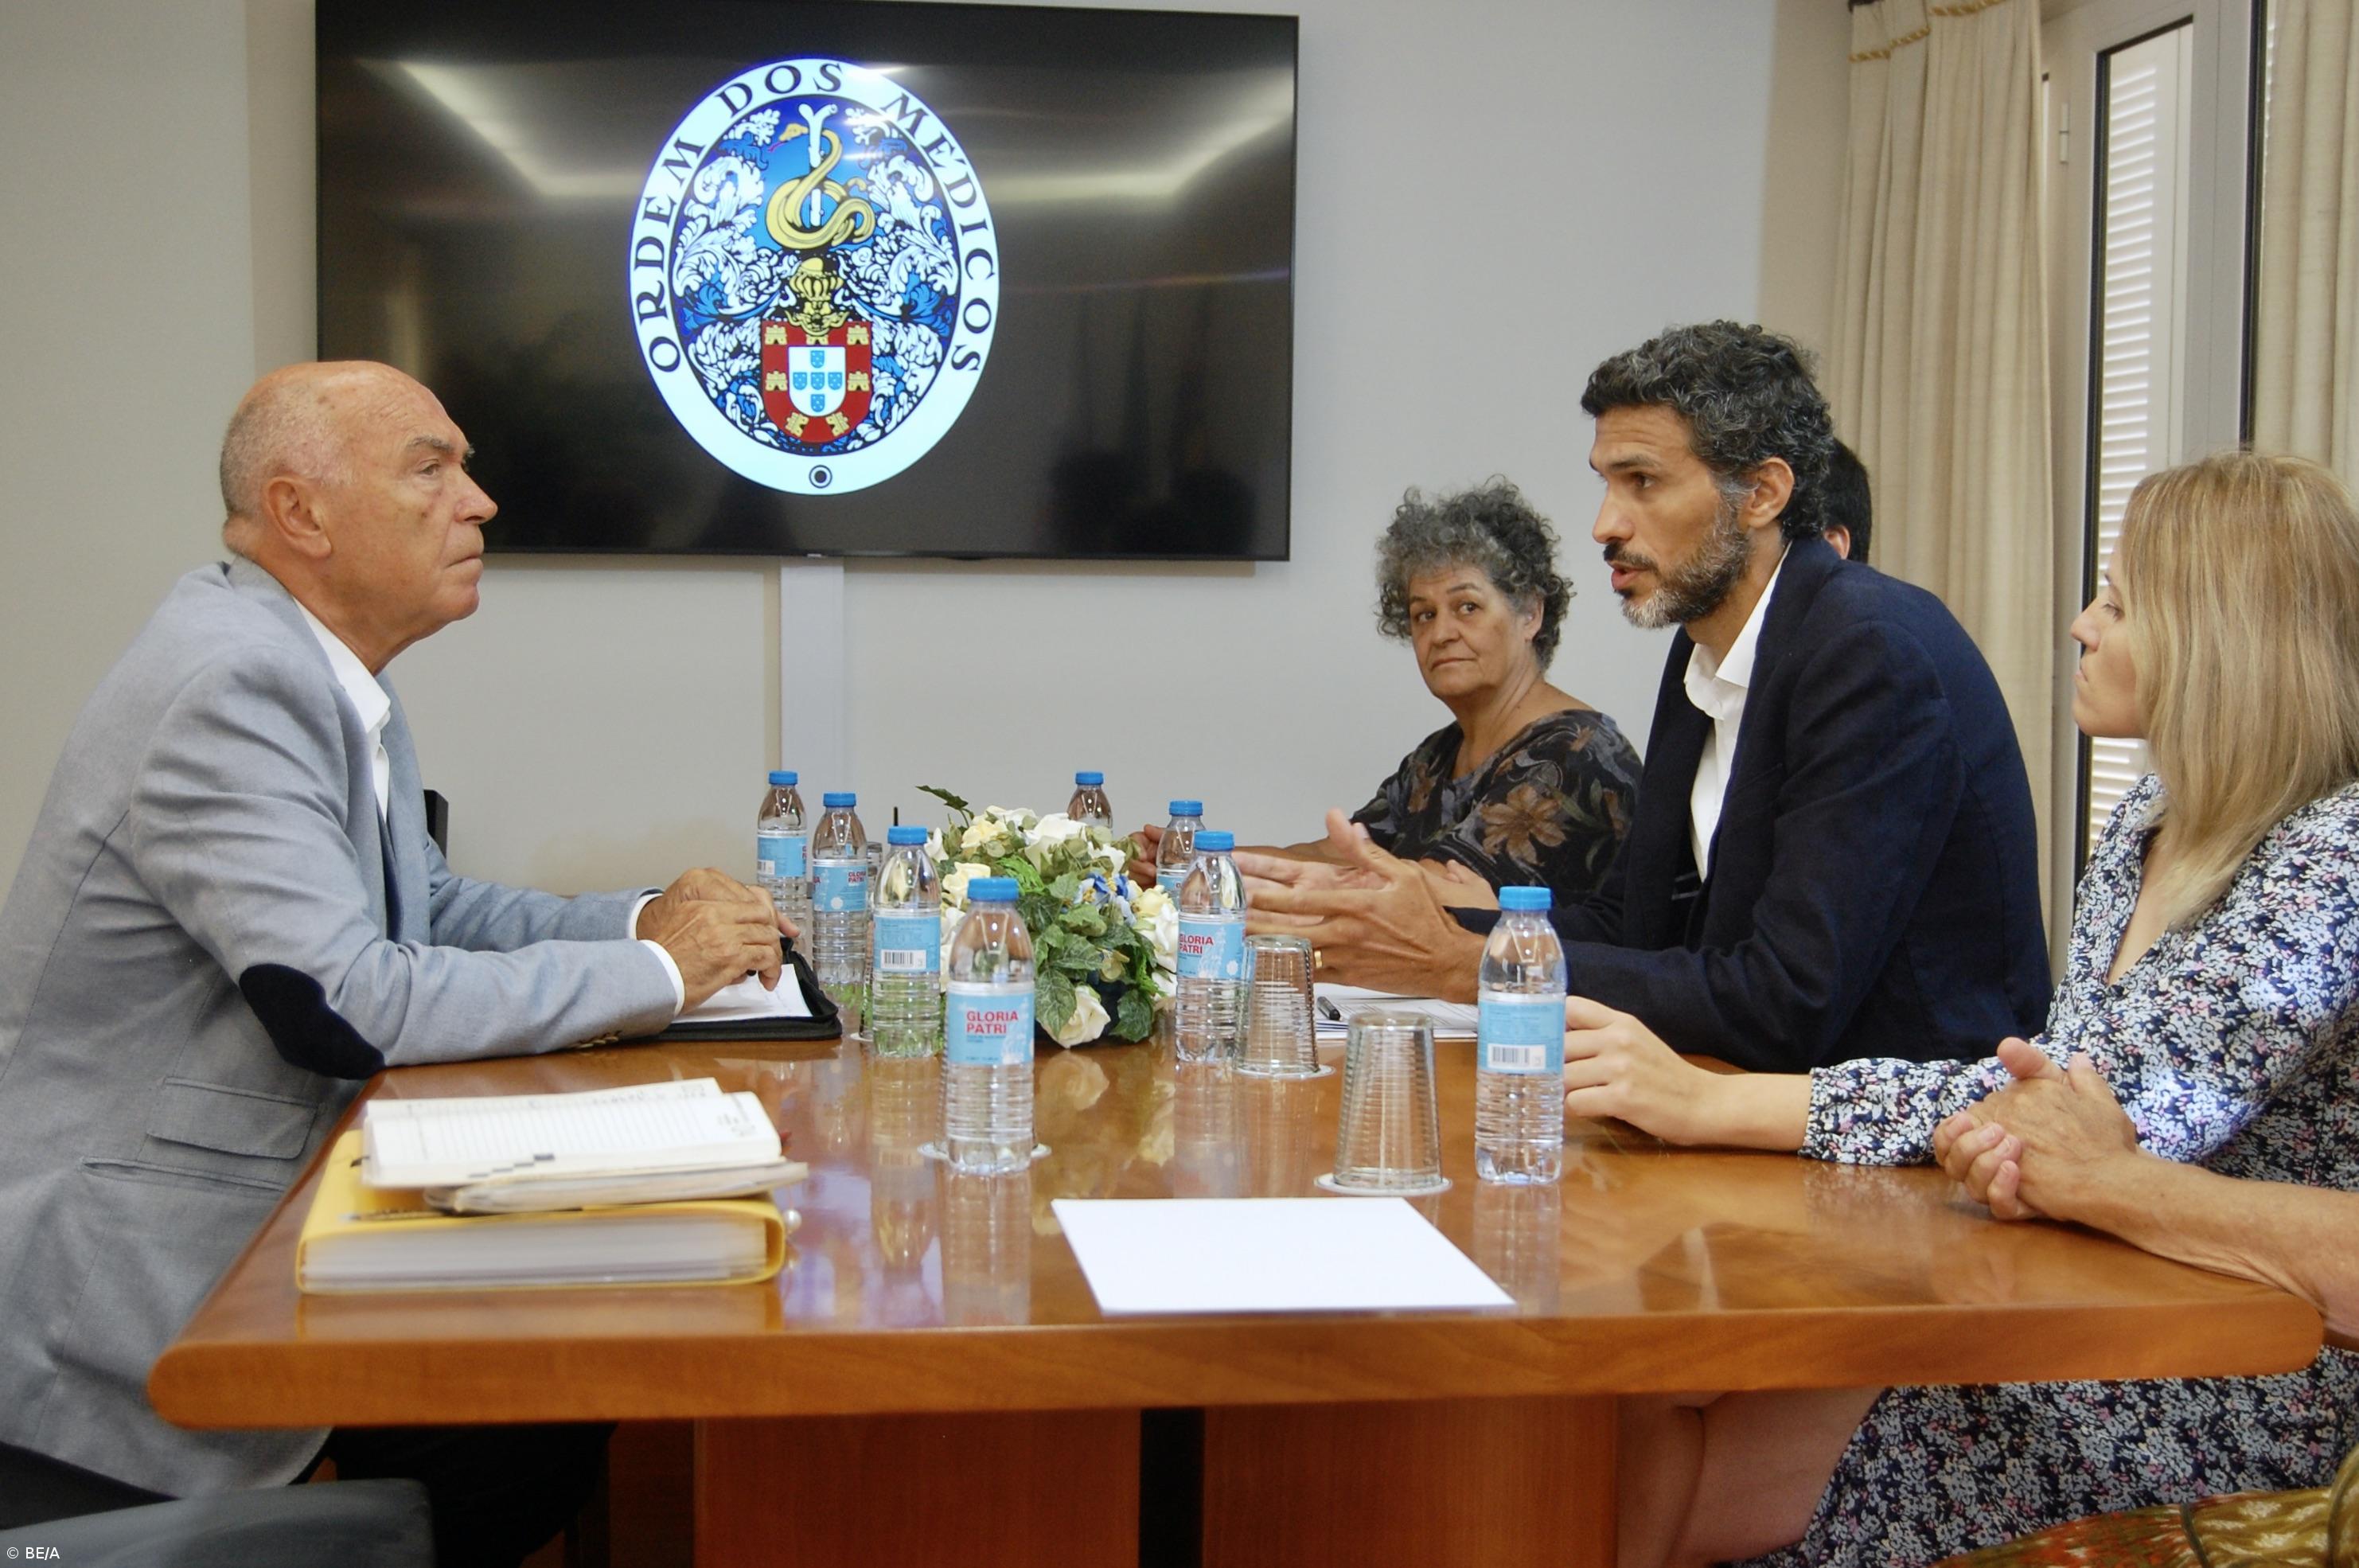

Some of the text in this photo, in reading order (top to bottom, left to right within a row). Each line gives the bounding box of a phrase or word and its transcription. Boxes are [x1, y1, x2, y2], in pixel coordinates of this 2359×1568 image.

[634, 137, 706, 372] ORDEM
[715, 63, 843, 118] DOS
[1179, 933, 1214, 946] GLORIA
[966, 1010, 1018, 1022] GLORIA
[966, 1024, 1007, 1034] PATRI
